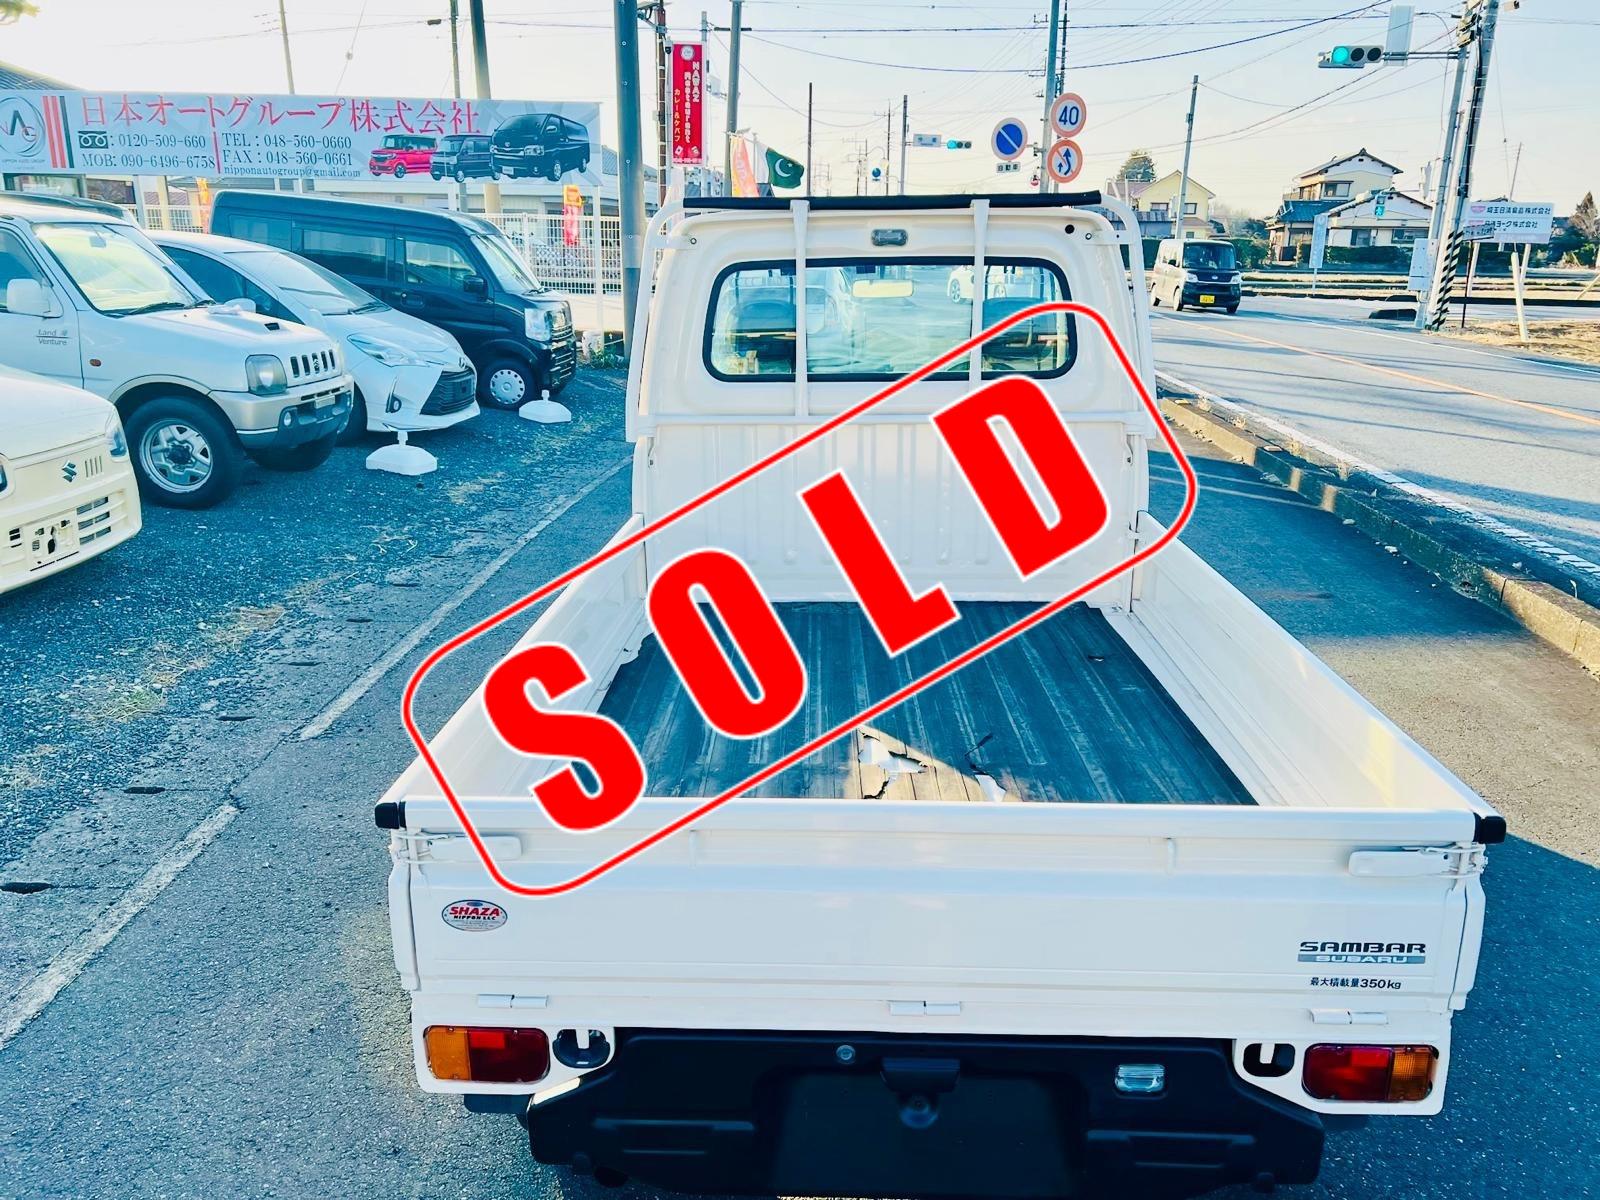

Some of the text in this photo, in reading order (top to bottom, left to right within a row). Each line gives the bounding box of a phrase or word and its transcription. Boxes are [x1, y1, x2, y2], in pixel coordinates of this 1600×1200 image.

[82, 94, 480, 134] 日本オートグループ株式会社
[1059, 106, 1079, 125] 40
[118, 134, 206, 148] 0120-509-660
[264, 134, 352, 149] 048-560-0660
[121, 155, 216, 169] 090-6496-6758
[266, 151, 353, 166] 048-560-0661
[224, 164, 361, 178] nipponautogroup@gmail.com
[449, 906, 500, 916] SHAZA
[1299, 941, 1426, 954] SAMBAR
[1315, 955, 1408, 964] SUBARU
